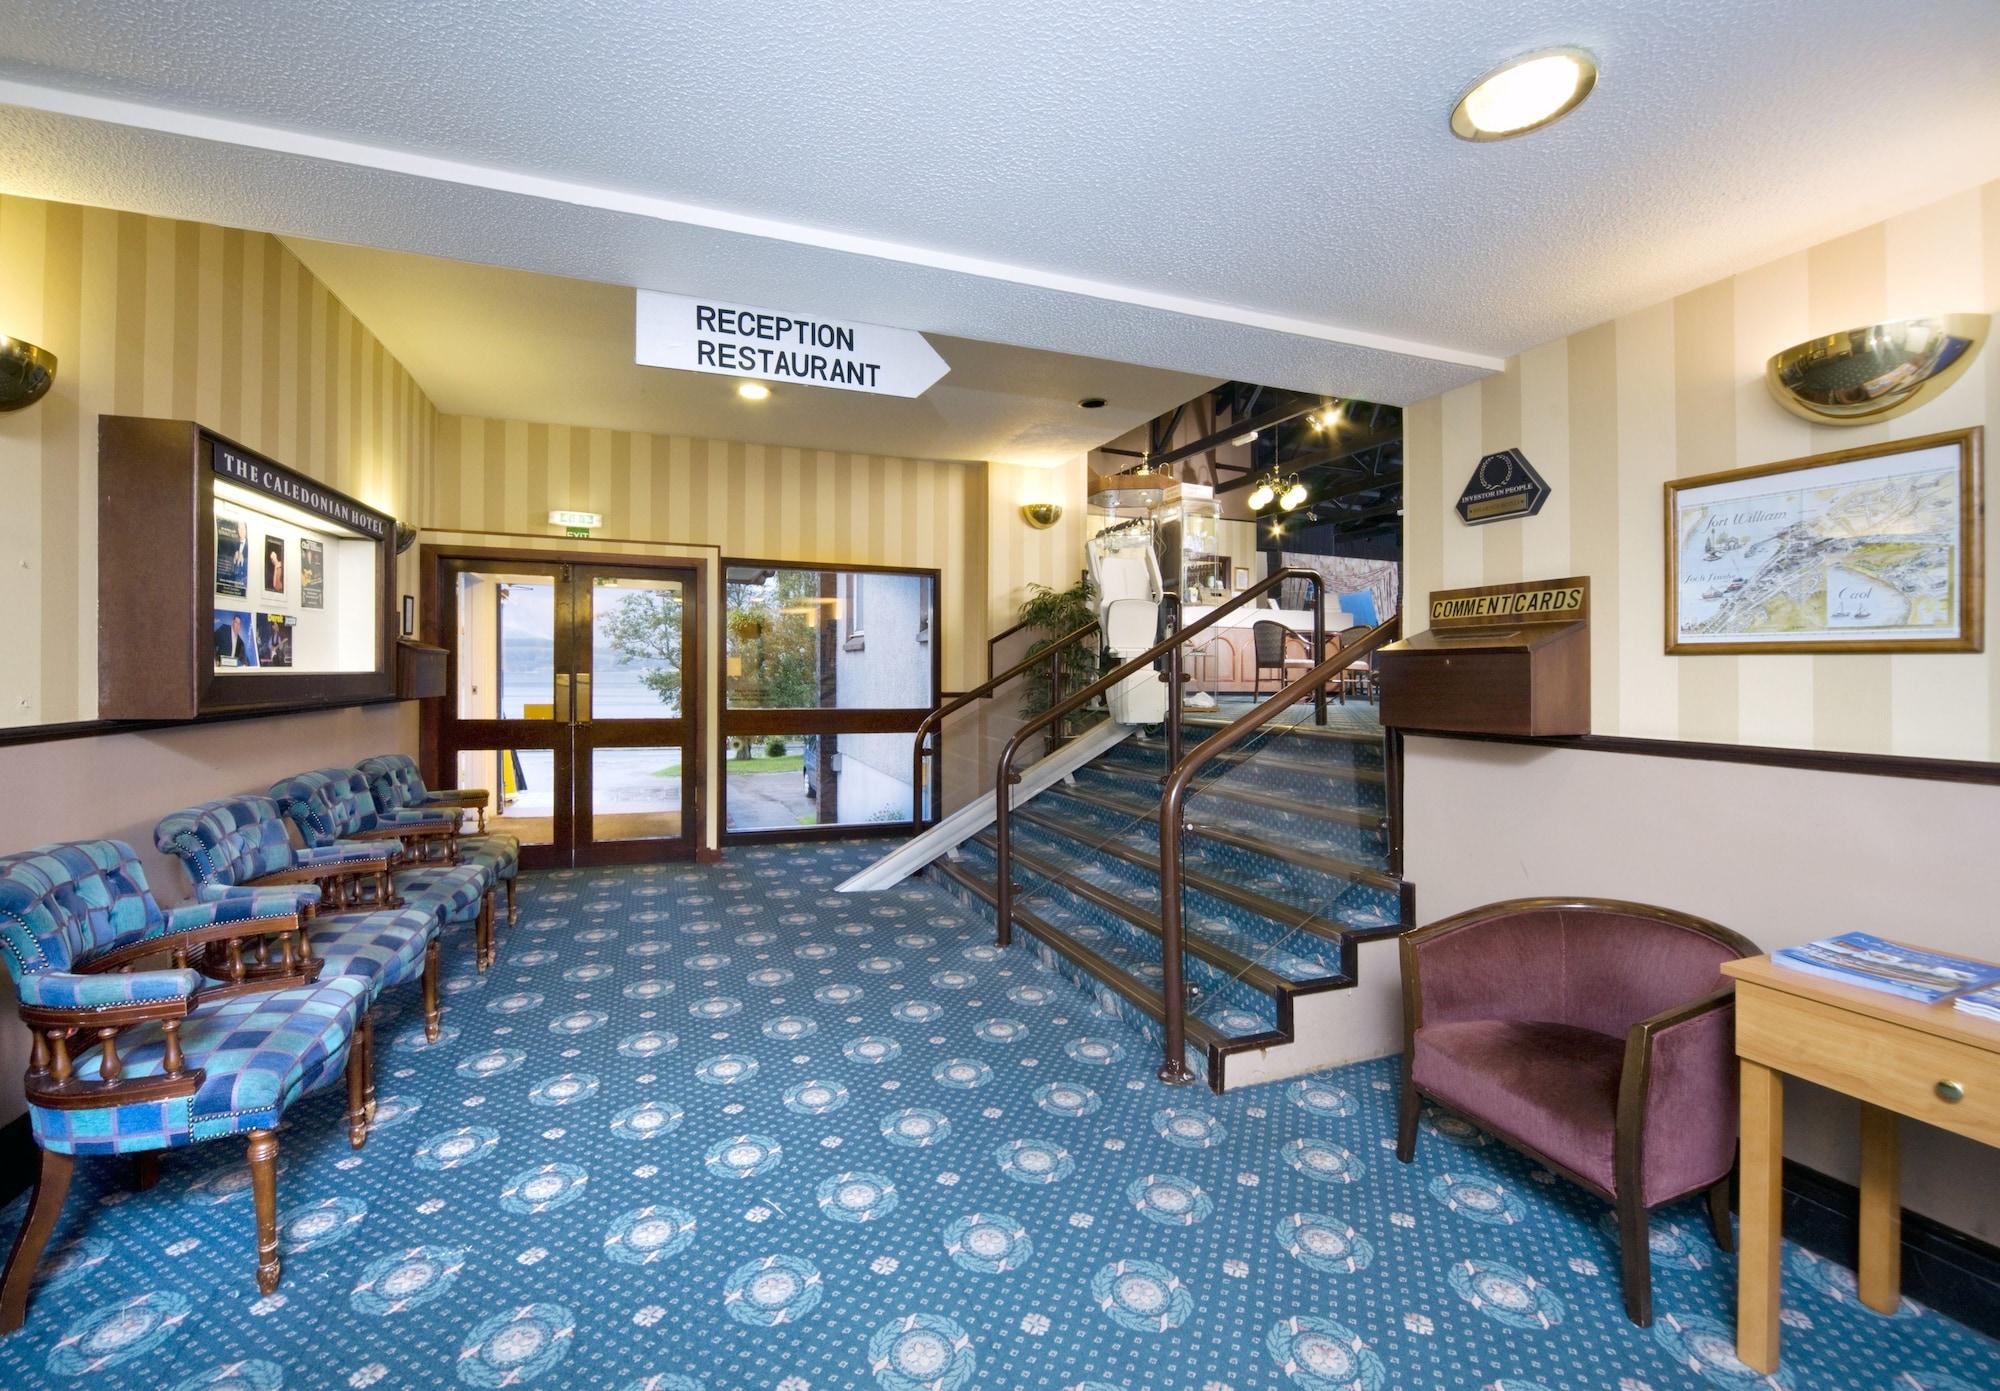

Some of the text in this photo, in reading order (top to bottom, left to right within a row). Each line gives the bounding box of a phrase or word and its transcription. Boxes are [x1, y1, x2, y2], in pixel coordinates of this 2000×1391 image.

[696, 305, 854, 352] RECEPTION
[697, 340, 881, 387] RESTAURANT
[224, 453, 384, 535] THE CALEDONIAN HOTEL
[1461, 482, 1534, 504] INVESTOR IN PEOPLE
[1733, 509, 1787, 526] William
[1432, 588, 1581, 619] COMMENT CARDS
[1838, 586, 1873, 600] Caol
